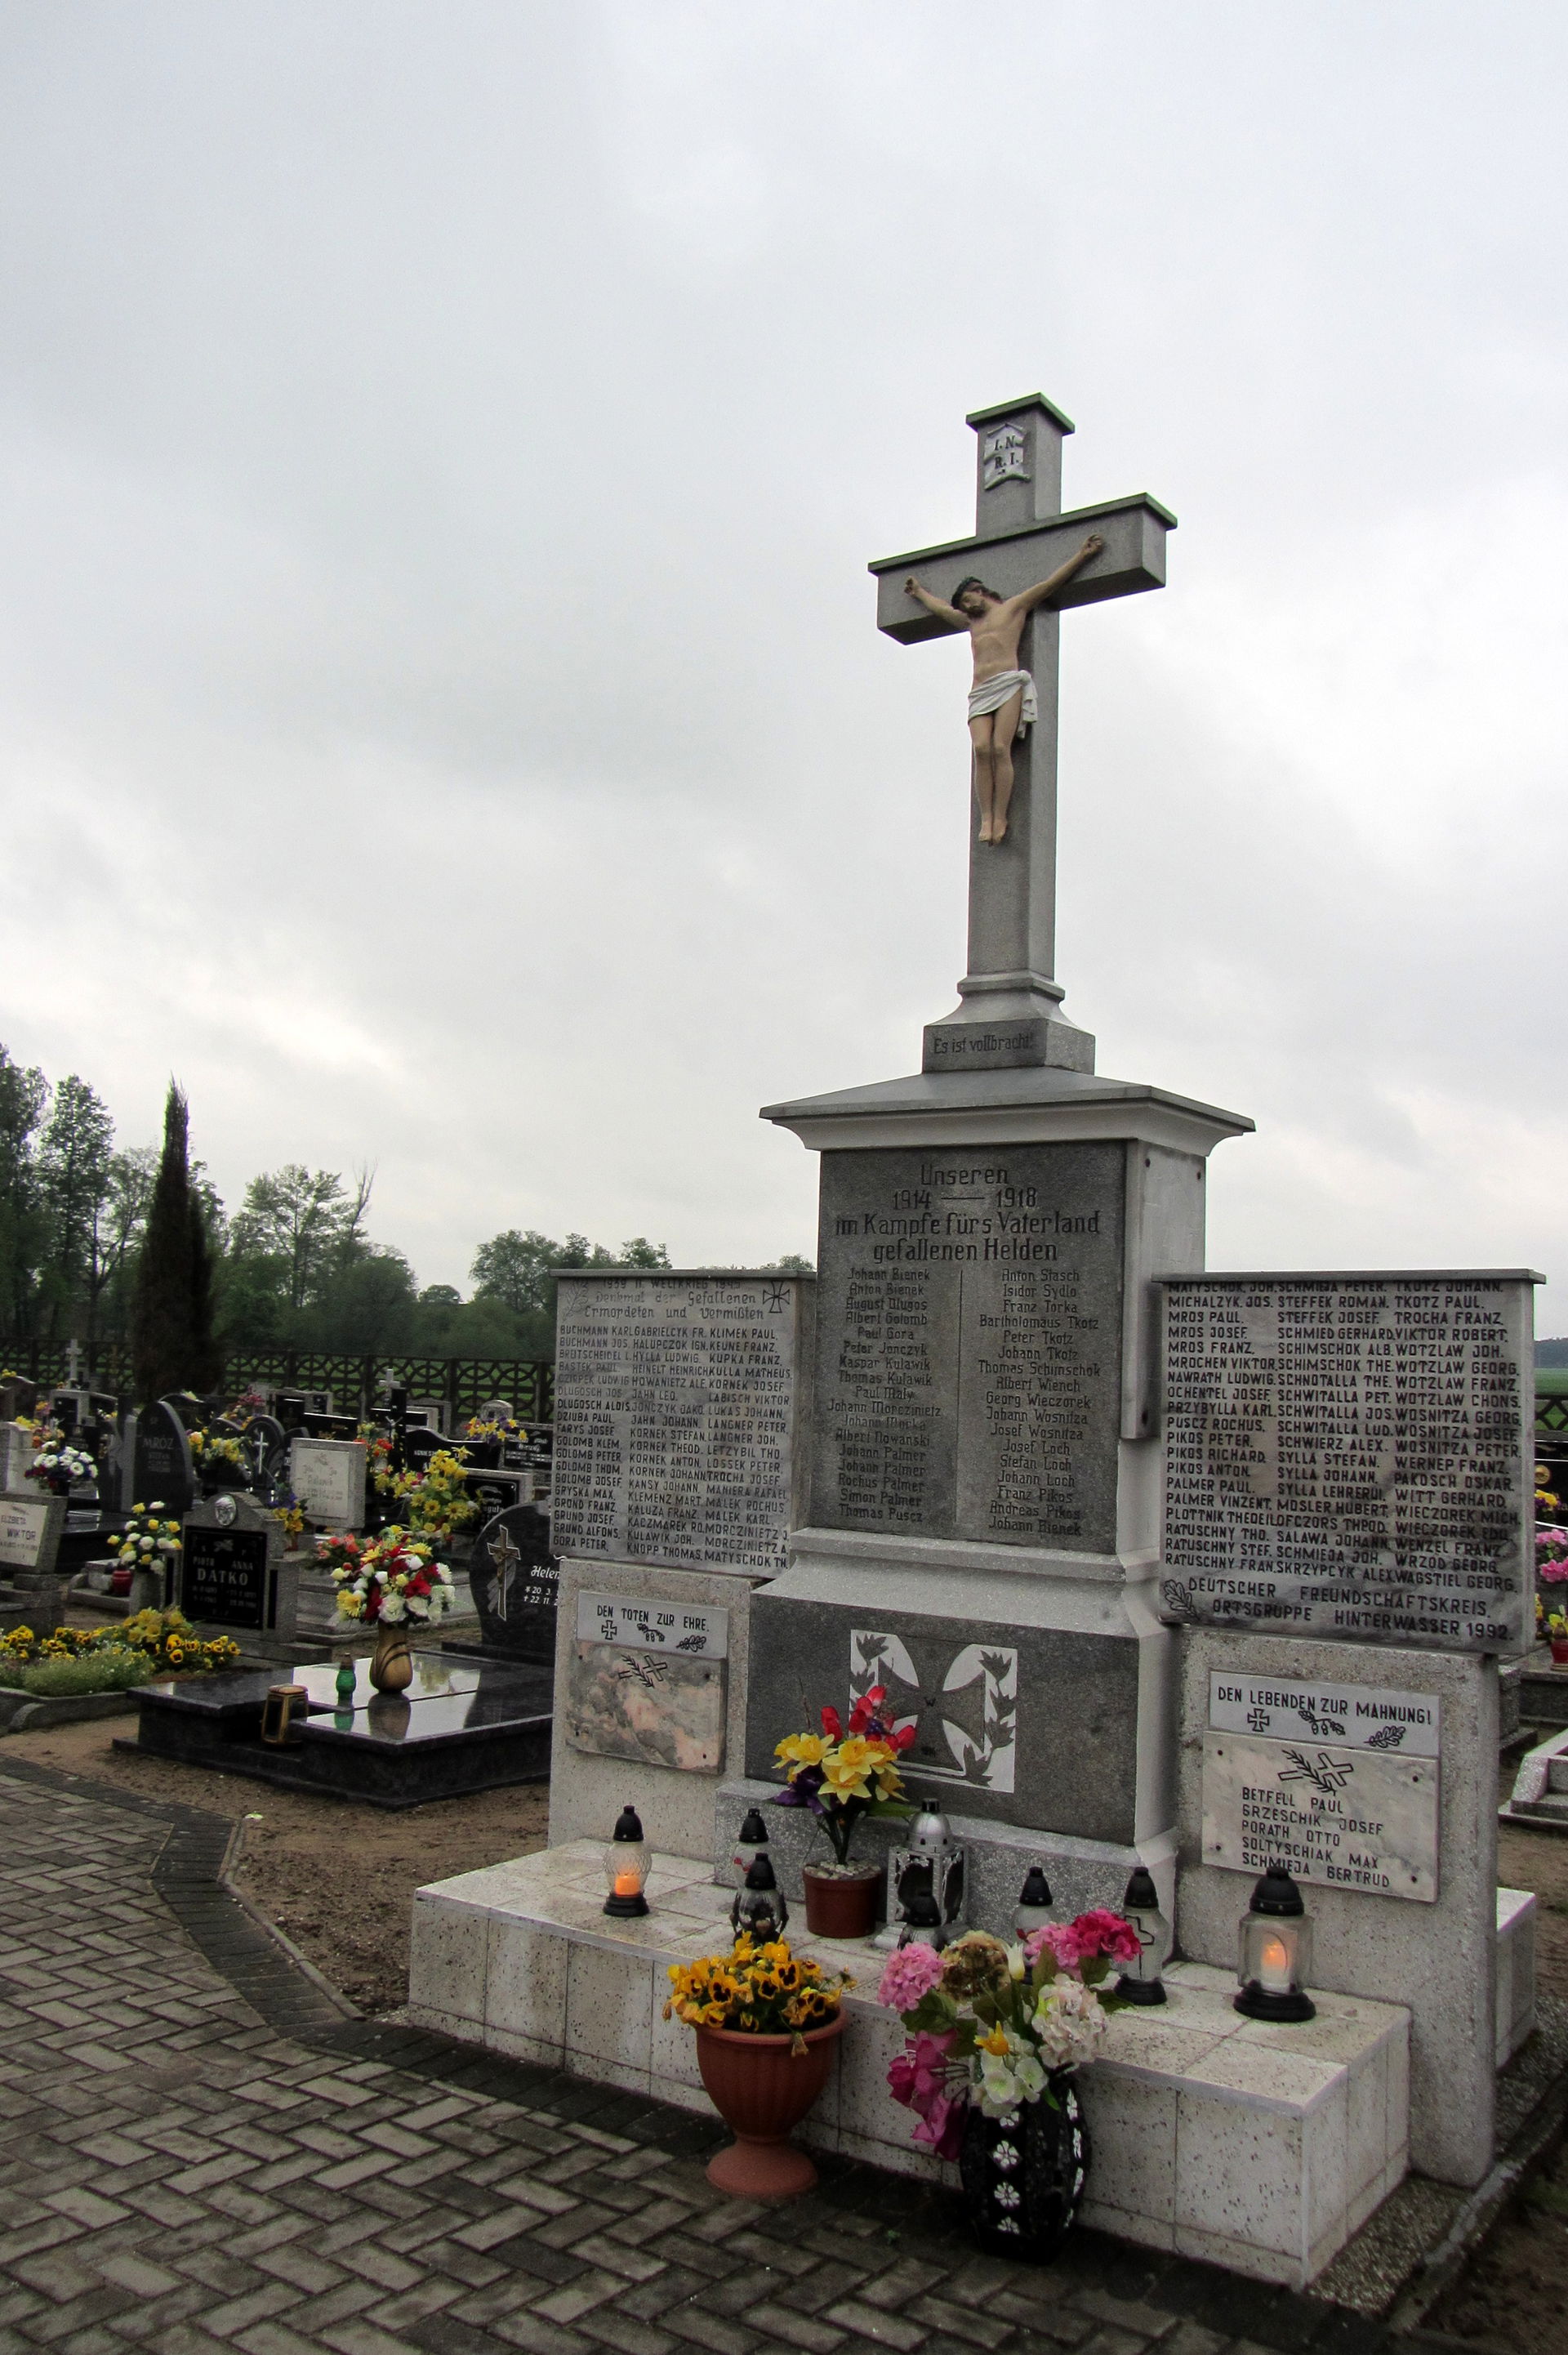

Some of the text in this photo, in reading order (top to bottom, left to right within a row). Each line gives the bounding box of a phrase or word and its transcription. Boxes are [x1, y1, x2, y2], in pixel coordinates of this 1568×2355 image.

[933, 1038, 948, 1054] Es
[952, 1037, 966, 1052] ist
[920, 1164, 1009, 1185] Unseren
[893, 1187, 1038, 1210] 1914 1918
[835, 1210, 1101, 1238] im Kampfe fürs Vaterland
[873, 1238, 1058, 1264] gefallenen Helden
[848, 1268, 930, 1281] Johann Bienek
[1002, 1269, 1080, 1282] Anton Stasch
[887, 1283, 924, 1295] Bienek
[1004, 1284, 1037, 1297] Isidor
[1004, 1300, 1078, 1313] Franz Torka
[1246, 1296, 1273, 1308] JOS.
[1278, 1296, 1389, 1308] STEFFEK ROMAN.
[1395, 1296, 1484, 1308] TKOTZ PAUL.
[666, 1307, 687, 1318] und
[1169, 1311, 1244, 1323] MROS PAUL.
[1278, 1312, 1379, 1324] STEFFEK JOSEF.
[1395, 1312, 1503, 1325] TROCHA FRANZ.
[710, 1328, 747, 1339] KLIMEK
[1004, 1331, 1073, 1345] Peter Tkotz
[1169, 1327, 1248, 1339] MROS JOSEF.
[1278, 1327, 1395, 1340] SCHMIED GERHARD.
[1396, 1328, 1508, 1342] VIKTOR ROBERT.
[1169, 1342, 1254, 1354] MROS FRANZ.
[1396, 1345, 1503, 1358] WOTZLAW JOH.
[710, 1354, 782, 1366] KUPKA FRANZ.
[840, 1354, 931, 1371] Kaspar Kulawik
[978, 1360, 1023, 1373] Thomas
[1168, 1357, 1278, 1372] MROCHEN VIKTOR.
[1396, 1361, 1519, 1376] WOTZLAW GEORG.
[996, 1376, 1080, 1393] Albert Wiench
[1168, 1372, 1276, 1385] NAWRATH LUDWIG.
[987, 1391, 1091, 1408] Georg Wieczorek
[1168, 1387, 1271, 1402] OCHENTEL JOSEF.
[987, 1407, 1088, 1424] Johann Wosnitza
[1168, 1417, 1265, 1432] PUSCZ ROCHUS.
[557, 1437, 593, 1447] GOLOMB
[1167, 1432, 1253, 1447] PIKOS PETER.
[1278, 1436, 1388, 1452] SCHWIERZ ALEX.
[1003, 1439, 1070, 1456] Josef Loch
[707, 1458, 748, 1470] LOSSEK
[1000, 1455, 1071, 1470] Stefan Loch
[1278, 1452, 1379, 1468] SYLLA STEFAN.
[839, 1473, 925, 1492] Rochus Palmer
[555, 1486, 589, 1497] GRYSKA
[840, 1488, 922, 1506] Simon Palmer
[997, 1485, 1073, 1503] Franz Pikos
[1396, 1489, 1506, 1508] WITT GERHARD.
[706, 1511, 740, 1522] MALEK
[554, 1523, 620, 1539] GRUND ALFONS.
[1166, 1523, 1235, 1541] RATUSCHNY
[554, 1536, 608, 1551] GORA PETER.
[627, 1543, 702, 1561] KNOPP THOMAS.
[705, 1550, 771, 1567] MATYSCHOK
[197, 1568, 248, 1586] DATKO
[1188, 1577, 1491, 1618] DEUTSCHER FREUNDSCHAFTSKREIS.
[597, 1605, 710, 1632] DEN TOTEN ZUR EHRE.
[1213, 1599, 1312, 1621] ORTSGRUPPE
[1334, 1609, 1459, 1635] HINTERWASSER
[1218, 1687, 1431, 1724] DEN LEBENDEN ZUR MAHNUNG!
[1243, 1787, 1343, 1813] BETFELL PAUL
[1243, 1804, 1383, 1835] GRZESCHIK JOSEF
[1242, 1820, 1340, 1846] PORATH OTTO
[1242, 1837, 1379, 1868] SOLTYSCHIAK MAX
[1243, 1853, 1389, 1887] SCHMIEJA GERTRUD
